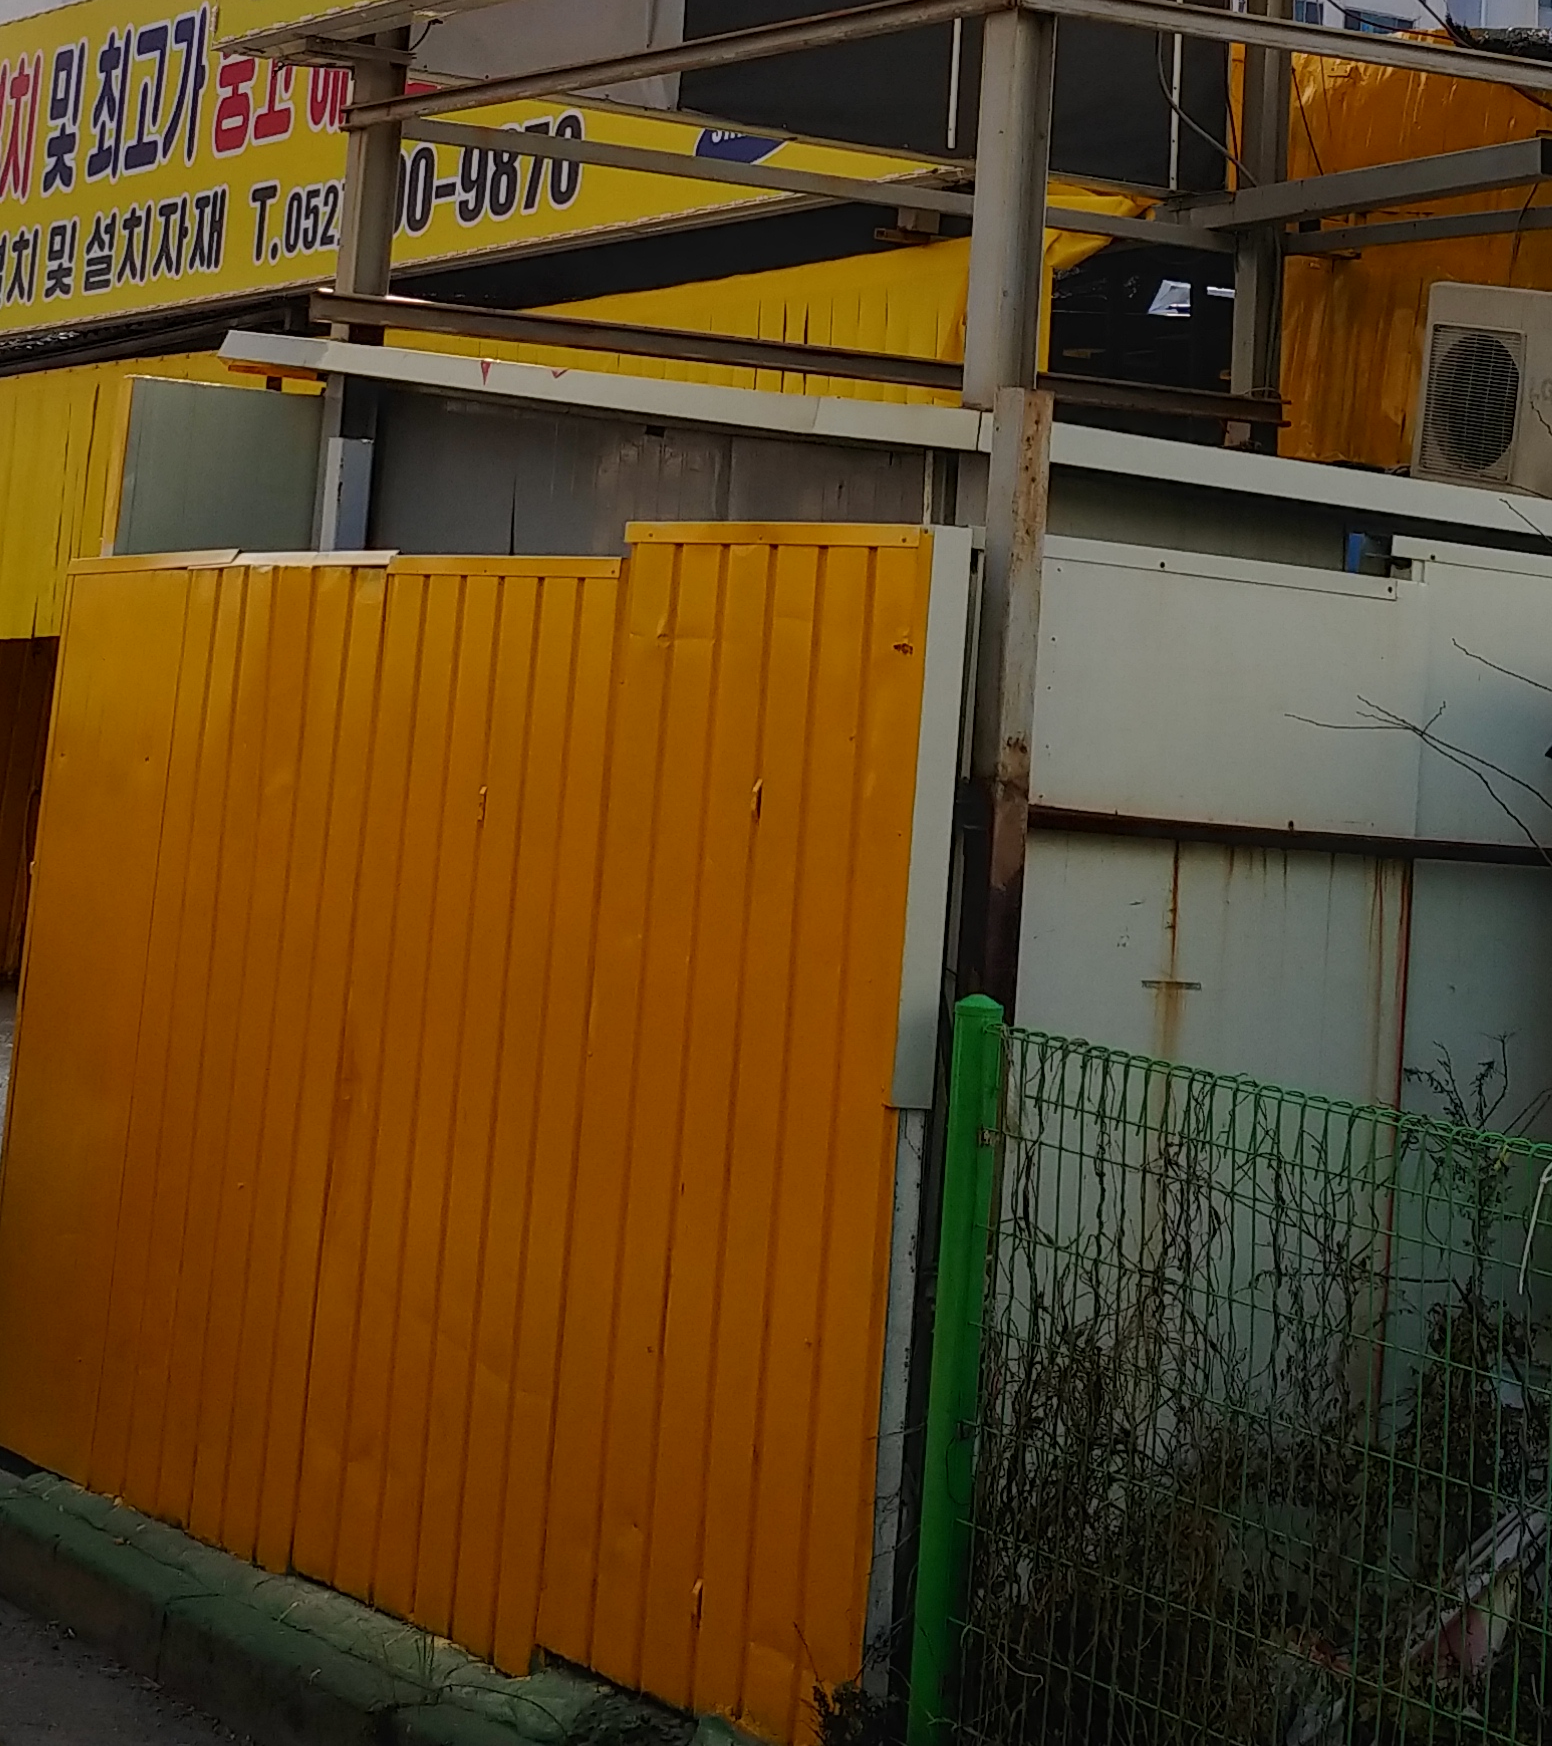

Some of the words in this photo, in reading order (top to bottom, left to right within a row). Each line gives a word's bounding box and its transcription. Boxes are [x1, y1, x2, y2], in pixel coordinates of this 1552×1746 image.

[40, 36, 89, 199] 및
[84, 0, 211, 184] 최고가
[42, 215, 80, 302] 및
[81, 182, 230, 296] 설치자재
